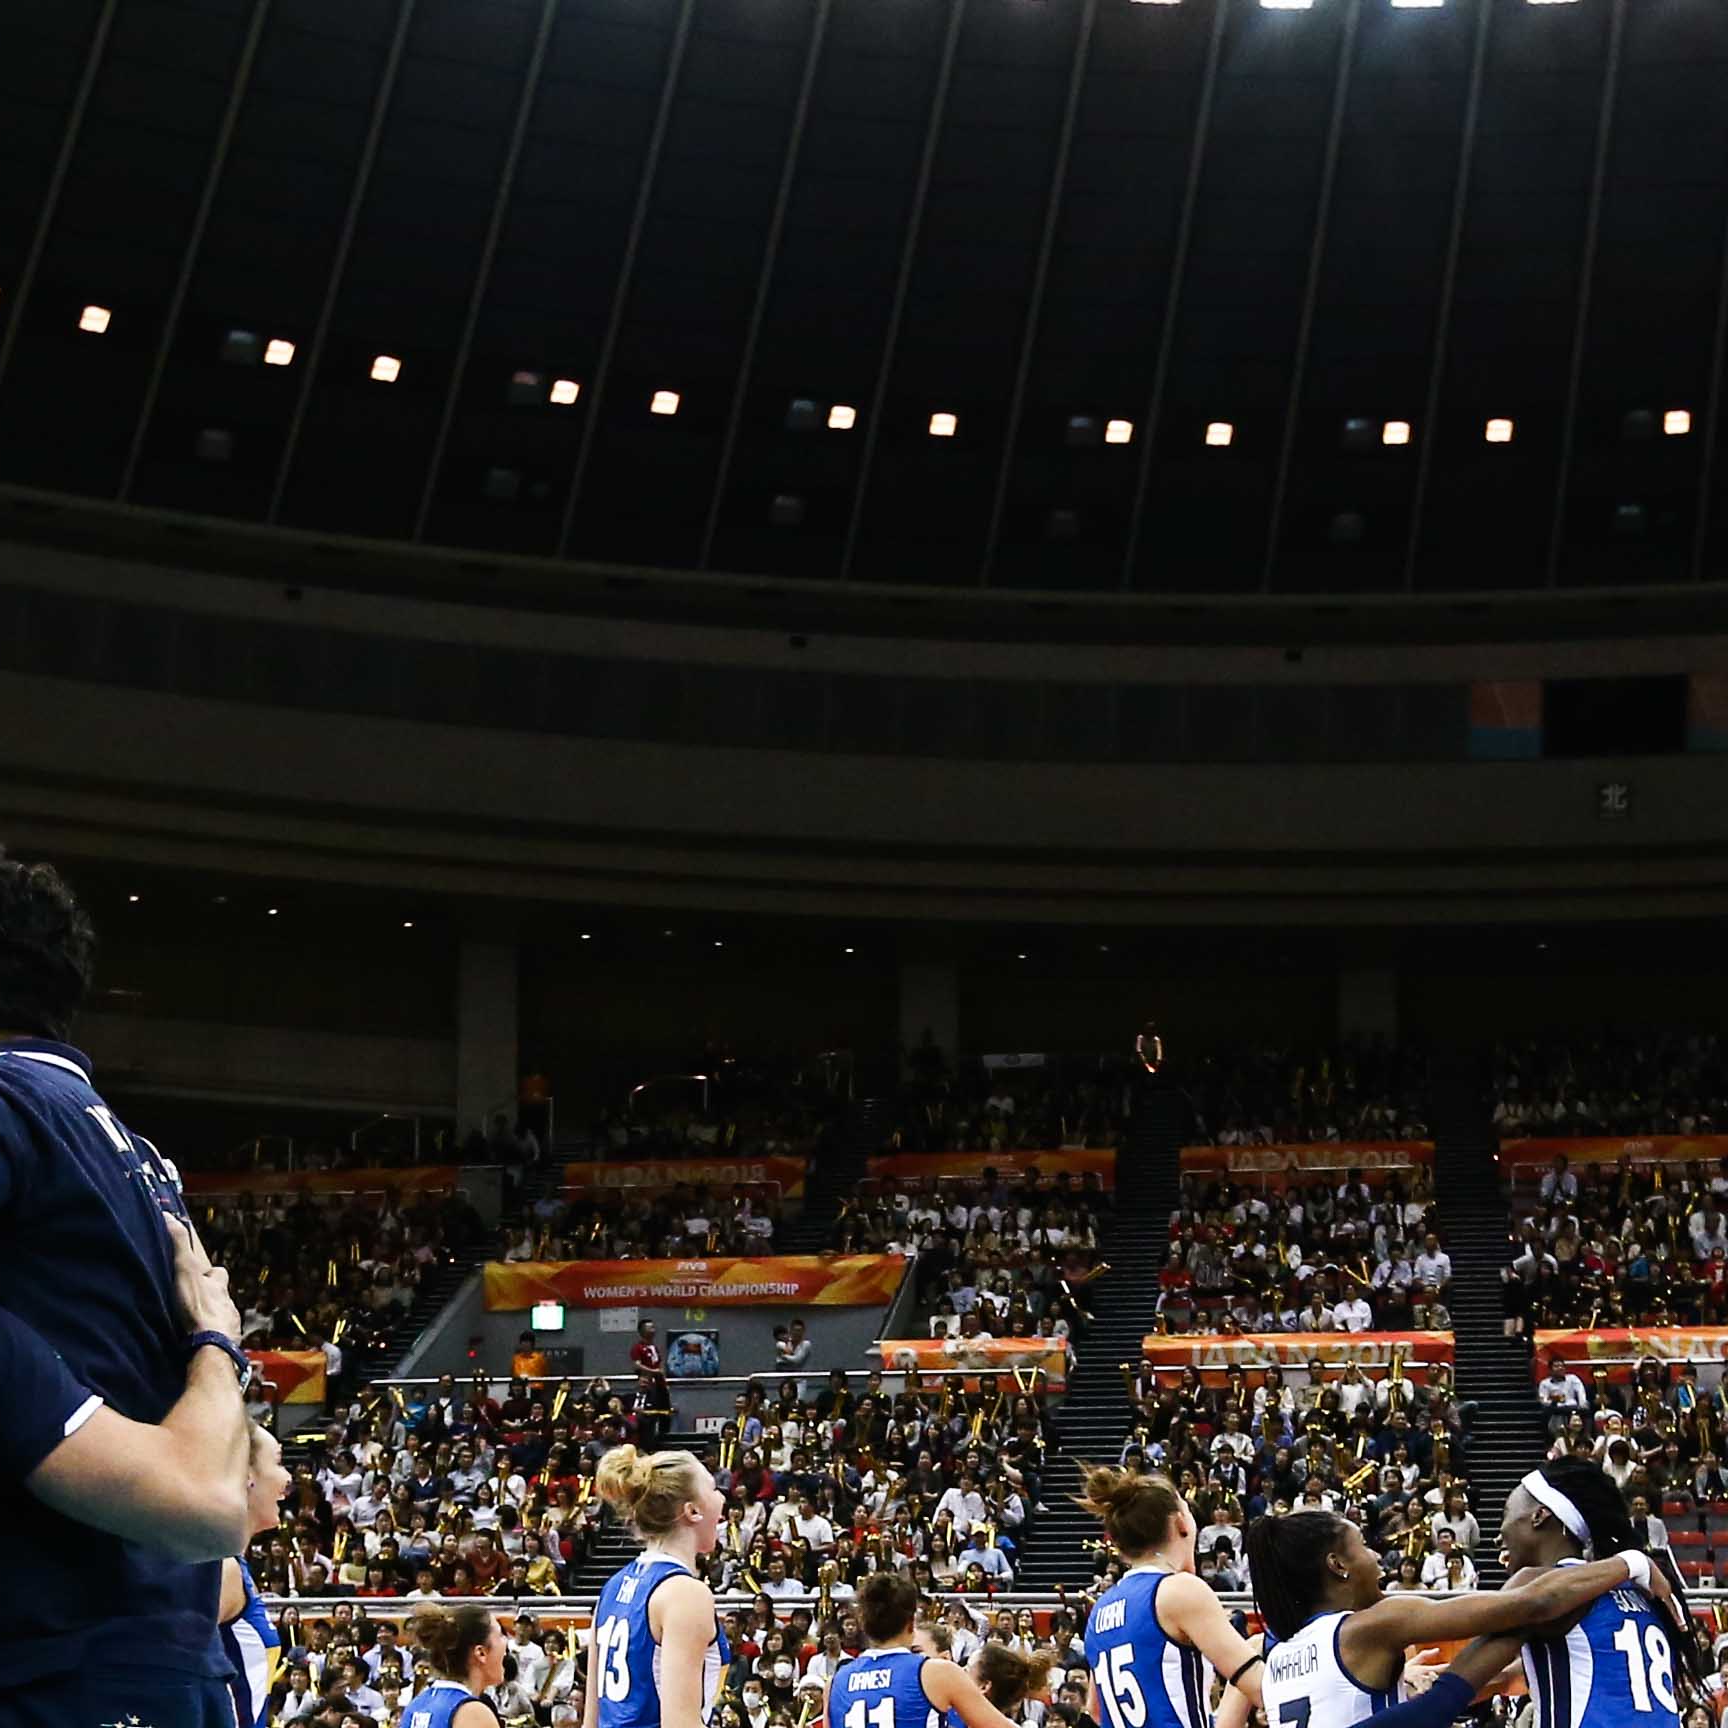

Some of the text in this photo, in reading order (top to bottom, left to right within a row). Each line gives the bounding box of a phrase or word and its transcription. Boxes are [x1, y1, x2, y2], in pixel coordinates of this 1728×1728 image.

[583, 1280, 800, 1299] WOMEN'S WORLD CHAMPIONSHIP
[1191, 1340, 1415, 1366] JAPAN 2018
[597, 1615, 631, 1703] 13
[1613, 1618, 1678, 1714] 18
[848, 1668, 892, 1693] DANESI
